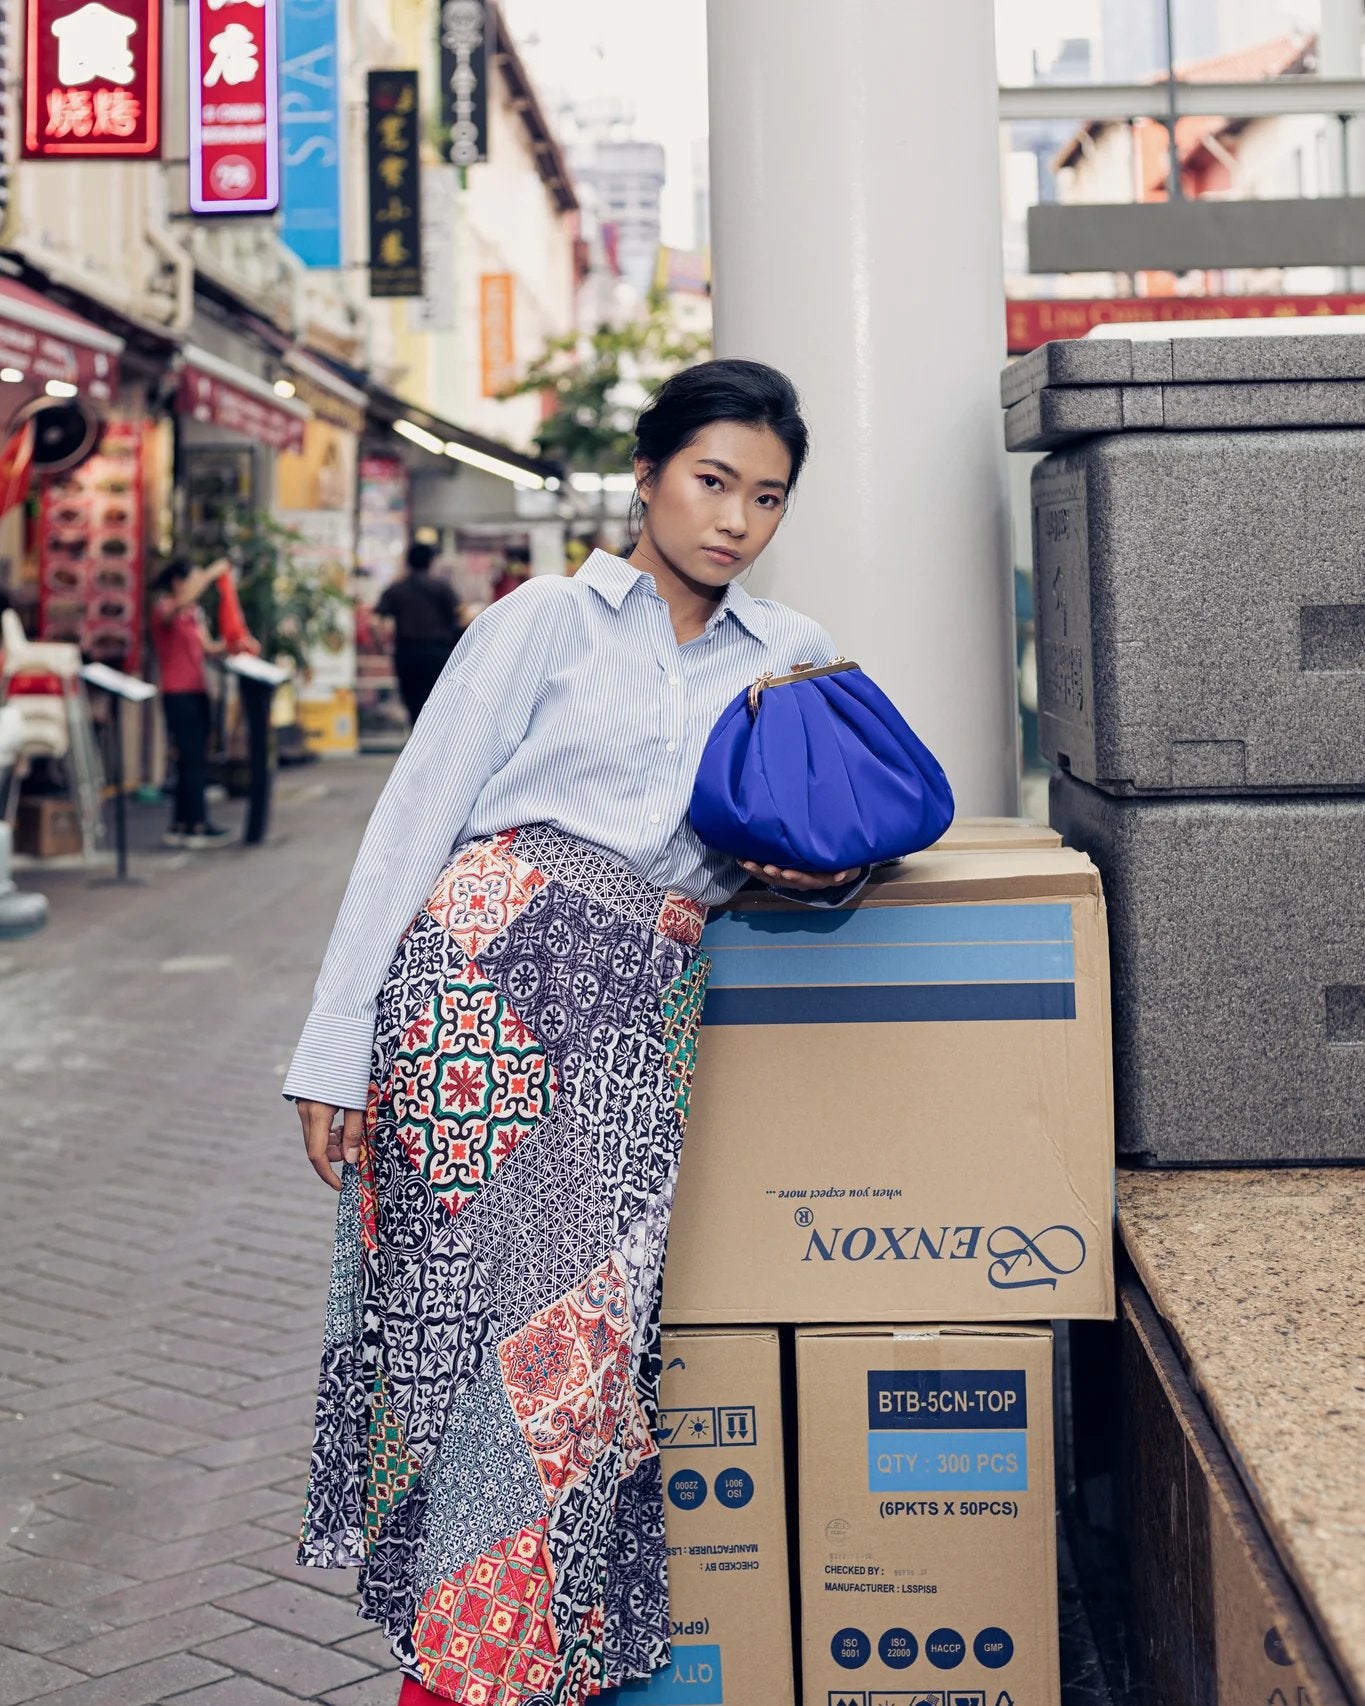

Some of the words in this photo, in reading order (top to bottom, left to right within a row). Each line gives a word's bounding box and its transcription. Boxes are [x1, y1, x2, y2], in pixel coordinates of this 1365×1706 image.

[279, 43, 337, 167] SPA
[778, 1190, 807, 1198] more
[810, 1187, 846, 1199] expect
[849, 1187, 871, 1197] you
[873, 1189, 902, 1199] when
[879, 1391, 1016, 1412] BTB-5CN-TOP
[877, 1454, 917, 1473] QTY
[937, 1454, 970, 1473] 300
[977, 1453, 1018, 1473] PCS
[675, 1481, 698, 1490] 22000
[725, 1479, 744, 1488] 9001
[680, 1491, 695, 1500] ISO
[727, 1489, 742, 1498] ISO
[879, 1501, 939, 1518] (6PKTS
[943, 1502, 955, 1515] X
[960, 1501, 1018, 1518] 50PCS)
[689, 1544, 758, 1555] MANUFACTURER
[705, 1563, 716, 1571] BY
[719, 1561, 759, 1571] CHECKED
[825, 1565, 865, 1575] CHECKED
[868, 1566, 879, 1575] BY
[825, 1582, 895, 1593] MANUFACTURER
[902, 1584, 938, 1594] LSSPISB
[670, 1617, 710, 1635] (6PK
[843, 1638, 858, 1647] ISO
[891, 1638, 906, 1647] ISO
[983, 1643, 1003, 1652] GMP
[841, 1649, 860, 1658] 9001
[887, 1648, 911, 1658] 22000
[931, 1644, 961, 1653] HACCP
[672, 1663, 713, 1683] QTY
